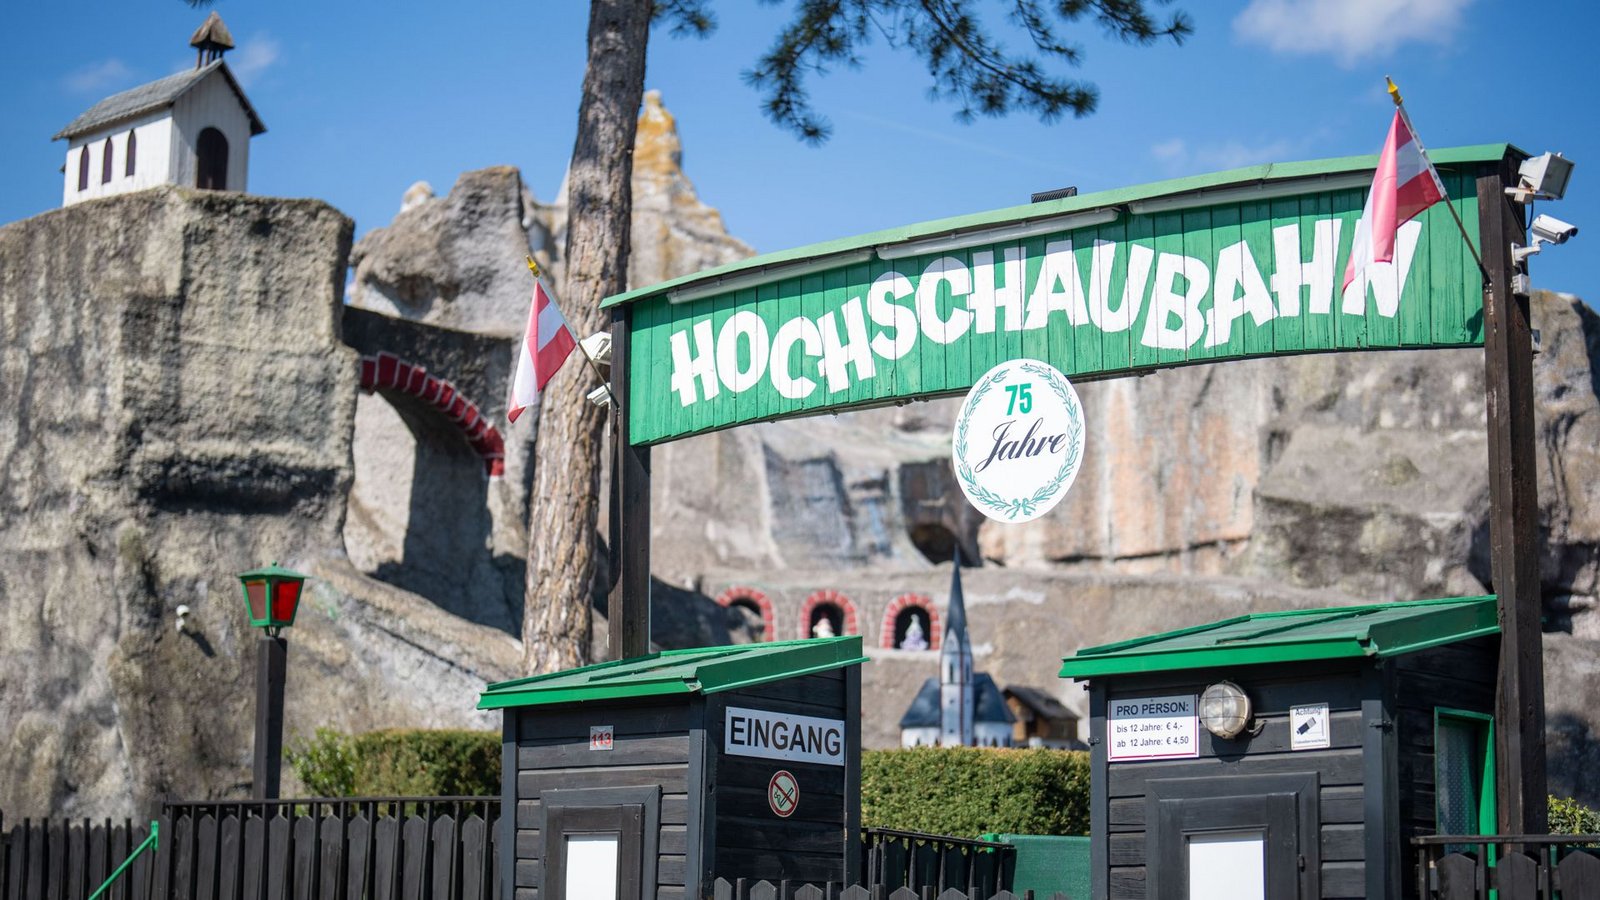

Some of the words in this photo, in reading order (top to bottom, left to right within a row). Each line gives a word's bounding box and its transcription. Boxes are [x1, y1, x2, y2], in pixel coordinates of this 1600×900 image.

[669, 217, 1423, 407] HOCHSCHAUBAHN
[1005, 382, 1033, 416] 75
[974, 417, 1067, 473] Jahre
[1116, 704, 1139, 716] PRO
[1141, 701, 1189, 714] PERSON:
[592, 732, 612, 746] 113
[730, 716, 841, 757] EINGANG
[1116, 725, 1128, 733] bis
[1130, 724, 1138, 732] 12
[1140, 722, 1163, 732] Jahre:
[1166, 722, 1171, 730] €
[1173, 722, 1183, 731] 4,-
[1116, 739, 1126, 747] ab
[1130, 738, 1138, 747] 12
[1140, 737, 1163, 747] Jahre:
[1166, 737, 1171, 745] €
